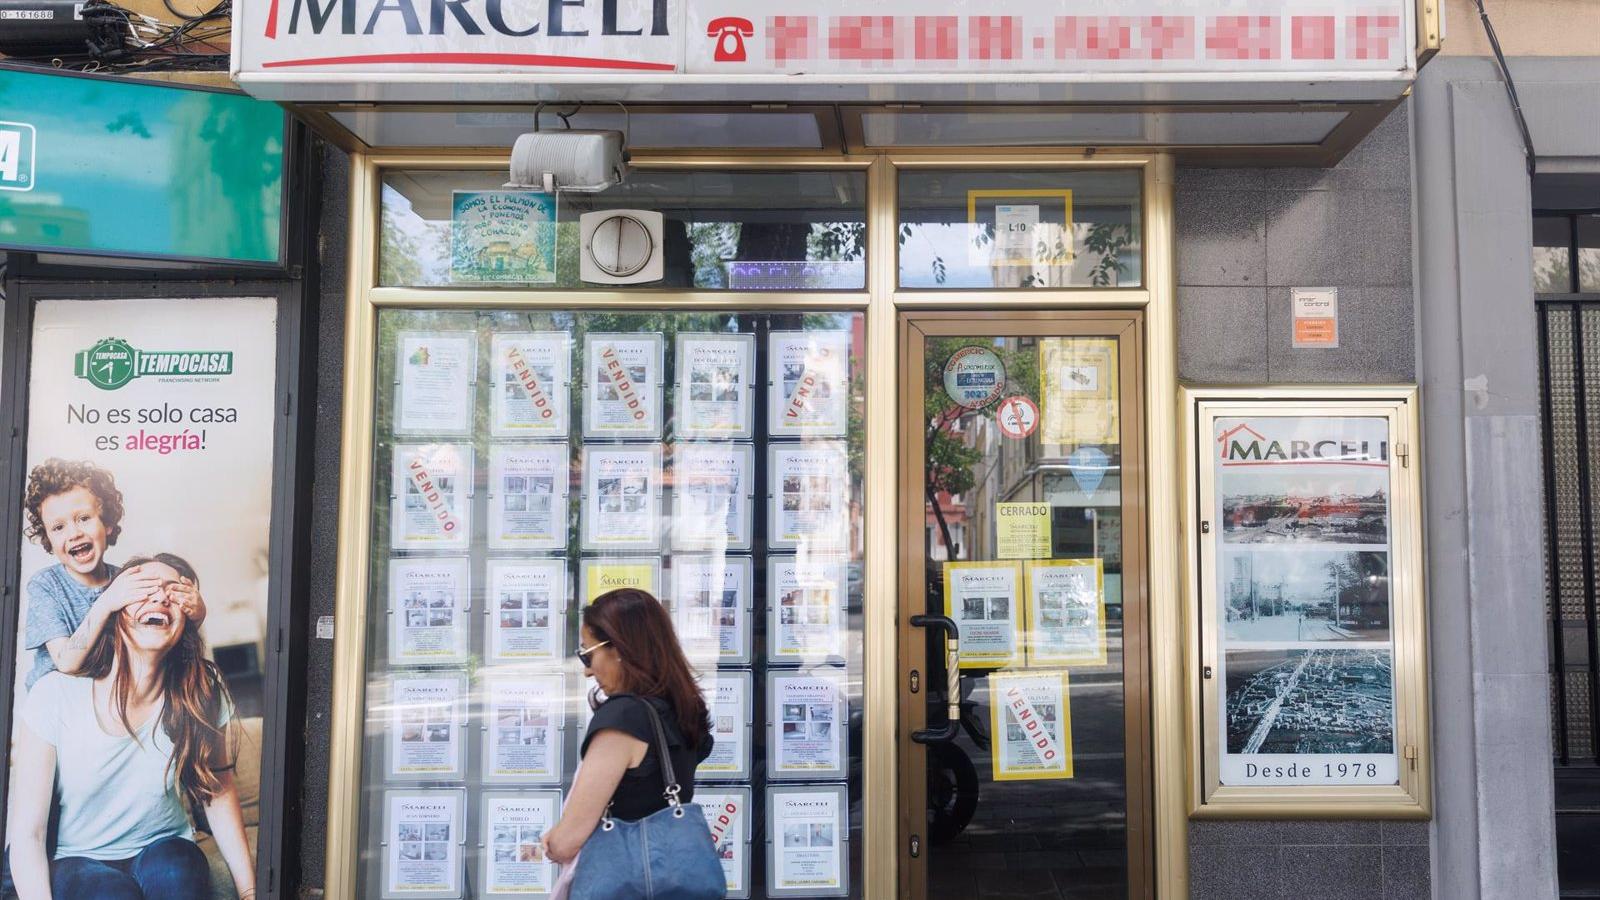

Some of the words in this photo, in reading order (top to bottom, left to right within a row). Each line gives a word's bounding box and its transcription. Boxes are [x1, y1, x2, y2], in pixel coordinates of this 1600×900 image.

[1009, 223, 1026, 232] L10
[95, 351, 128, 360] TEMPOCASA
[140, 353, 230, 373] TEMPOCASA
[508, 347, 552, 419] VENDIDO
[602, 349, 645, 421] VENDIDO
[67, 403, 100, 424] No
[107, 407, 131, 424] es
[137, 403, 183, 424] solo
[190, 406, 238, 423] casa
[95, 434, 120, 450] es
[125, 429, 207, 455] alegría!
[1229, 440, 1388, 461] MARCELI
[410, 461, 455, 532] VENDIDO
[1000, 506, 1047, 516] CERRADO
[1007, 686, 1056, 760] VENDIDO
[1246, 762, 1311, 778] Desde
[1324, 762, 1377, 778] 1978
